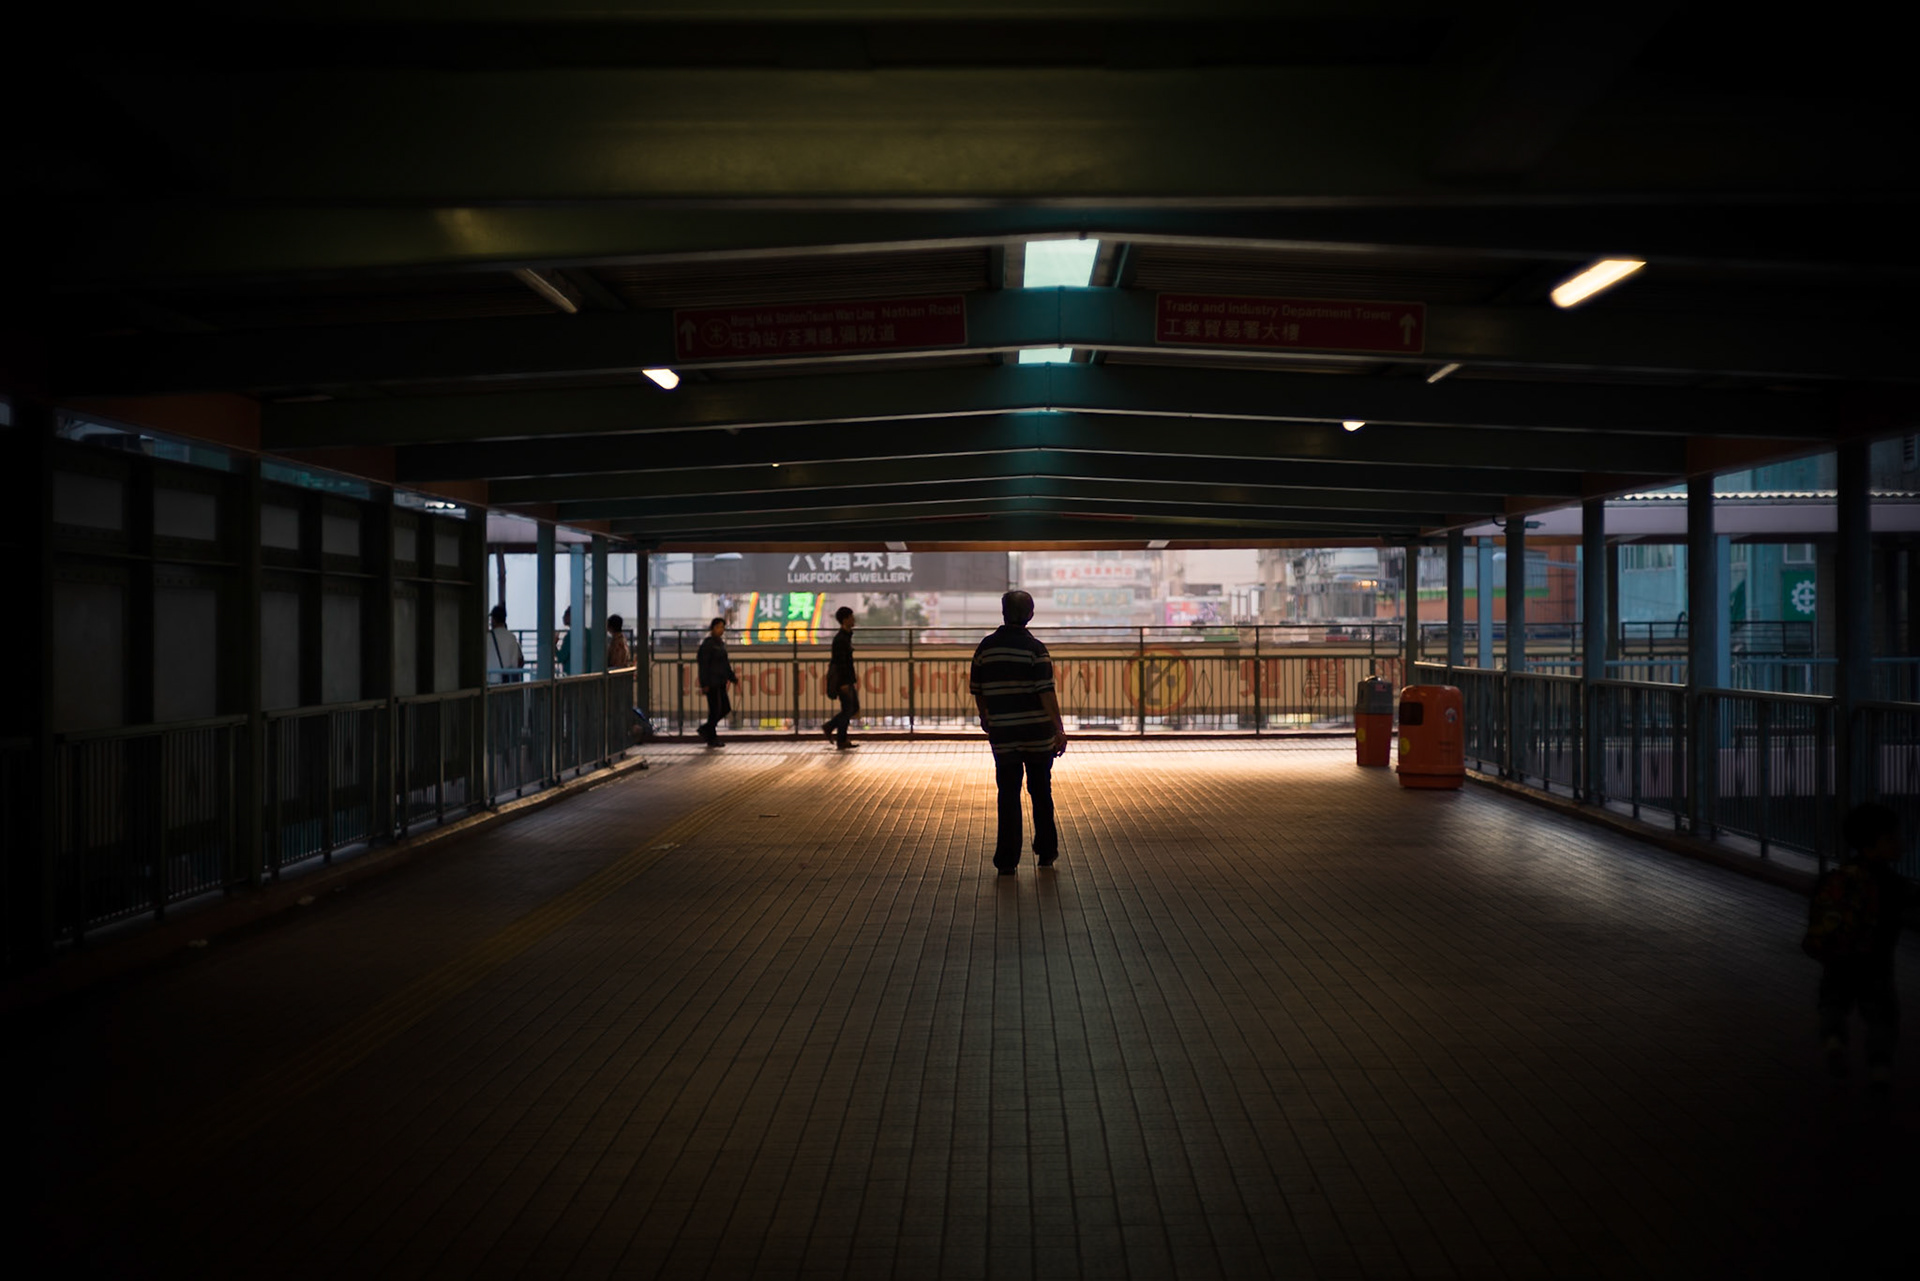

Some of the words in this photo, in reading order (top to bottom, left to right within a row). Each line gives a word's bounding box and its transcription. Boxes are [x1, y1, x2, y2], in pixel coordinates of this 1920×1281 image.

[856, 307, 875, 320] Line
[881, 305, 924, 319] Nathan
[928, 303, 960, 316] Road
[1165, 300, 1199, 313] Trade
[1202, 302, 1224, 314] and
[1228, 302, 1278, 317] Industry
[1281, 304, 1351, 321] Department
[1354, 307, 1393, 321] Tower
[787, 572, 841, 584] LUKFOOK
[844, 572, 914, 584] JEWELLERY
